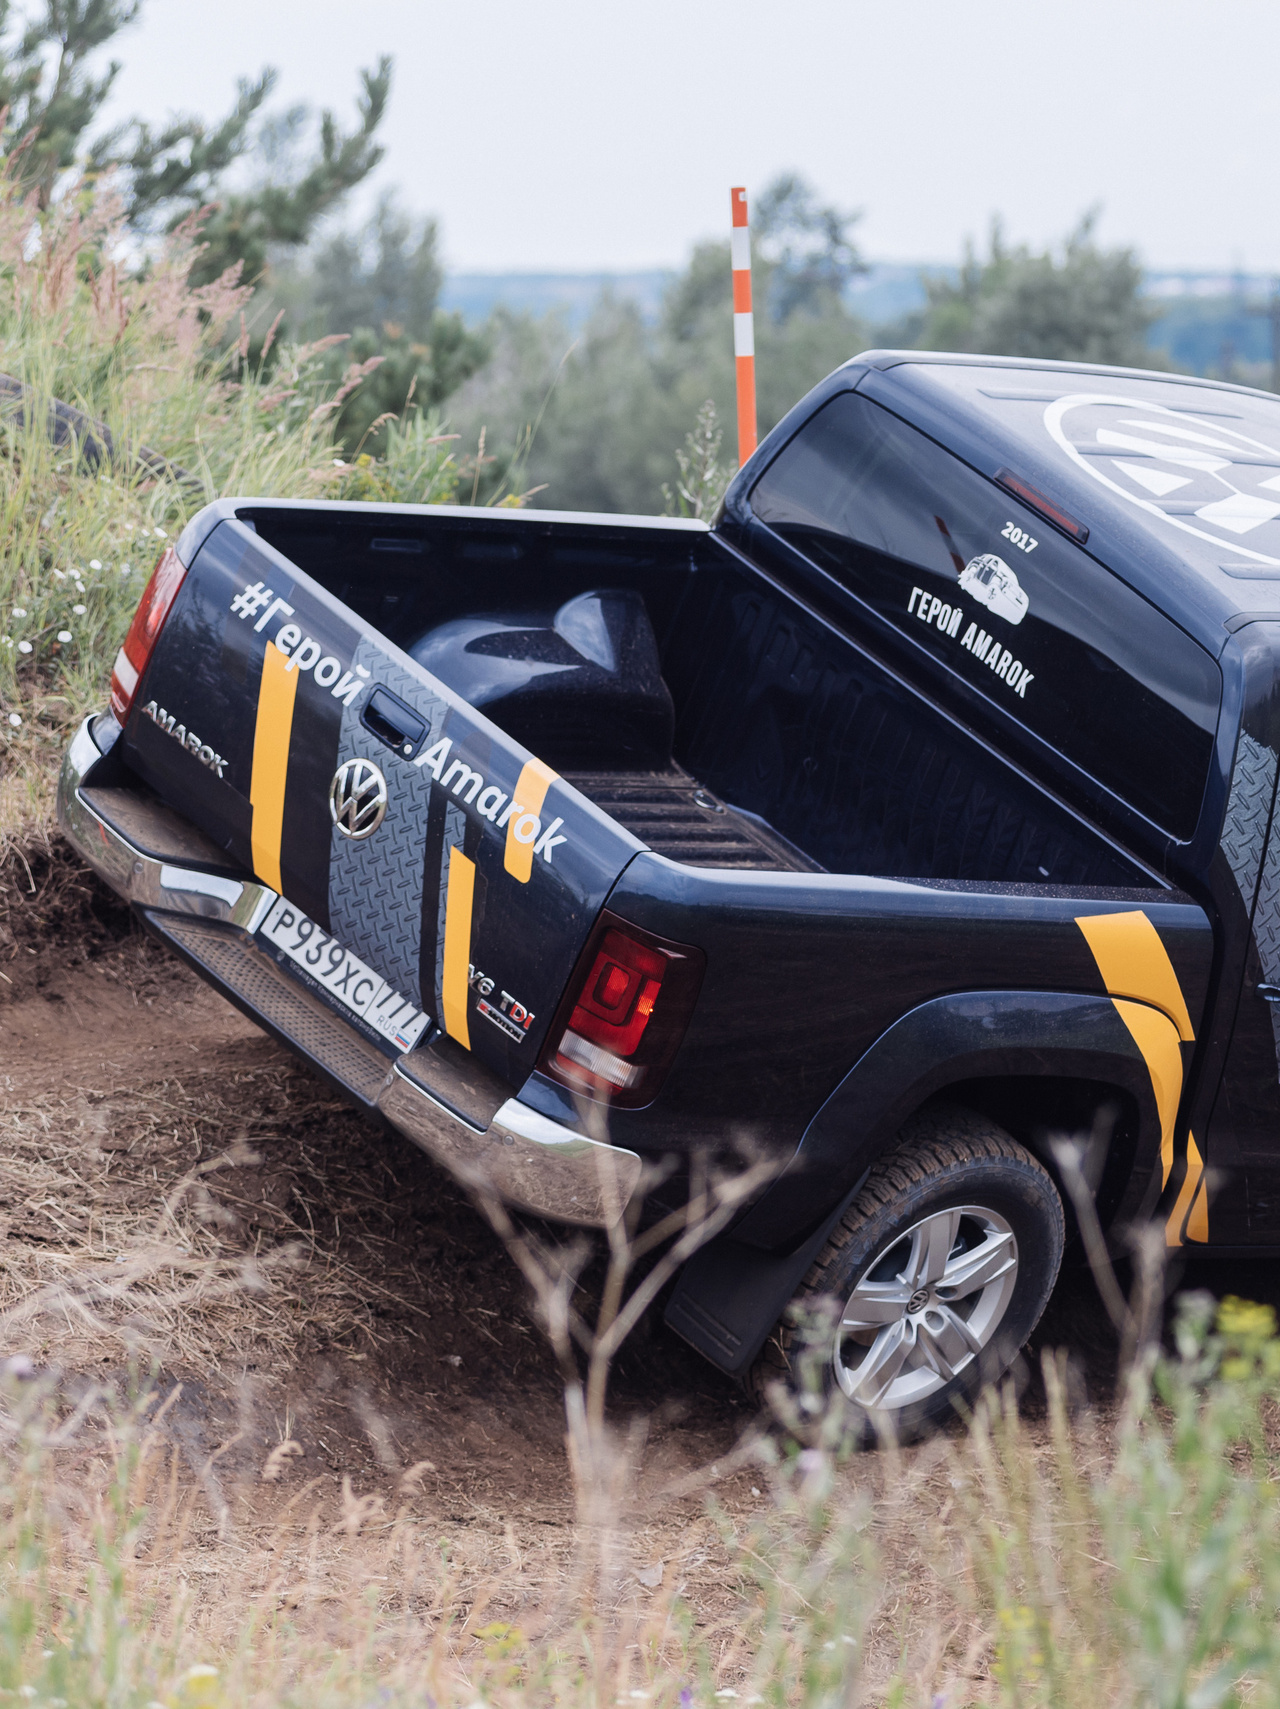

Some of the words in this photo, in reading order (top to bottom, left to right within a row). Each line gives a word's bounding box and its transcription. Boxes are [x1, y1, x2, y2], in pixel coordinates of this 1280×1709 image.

[1001, 521, 1038, 553] 2017
[907, 586, 963, 638] ГЕРОЙ
[960, 622, 1034, 698] AMAROK
[141, 700, 229, 778] AMAROK
[230, 581, 371, 707] #Герой
[413, 737, 567, 863] Amarok
[376, 1014, 397, 1037] RUS
[468, 963, 495, 996] V6
[500, 990, 535, 1030] TDI
